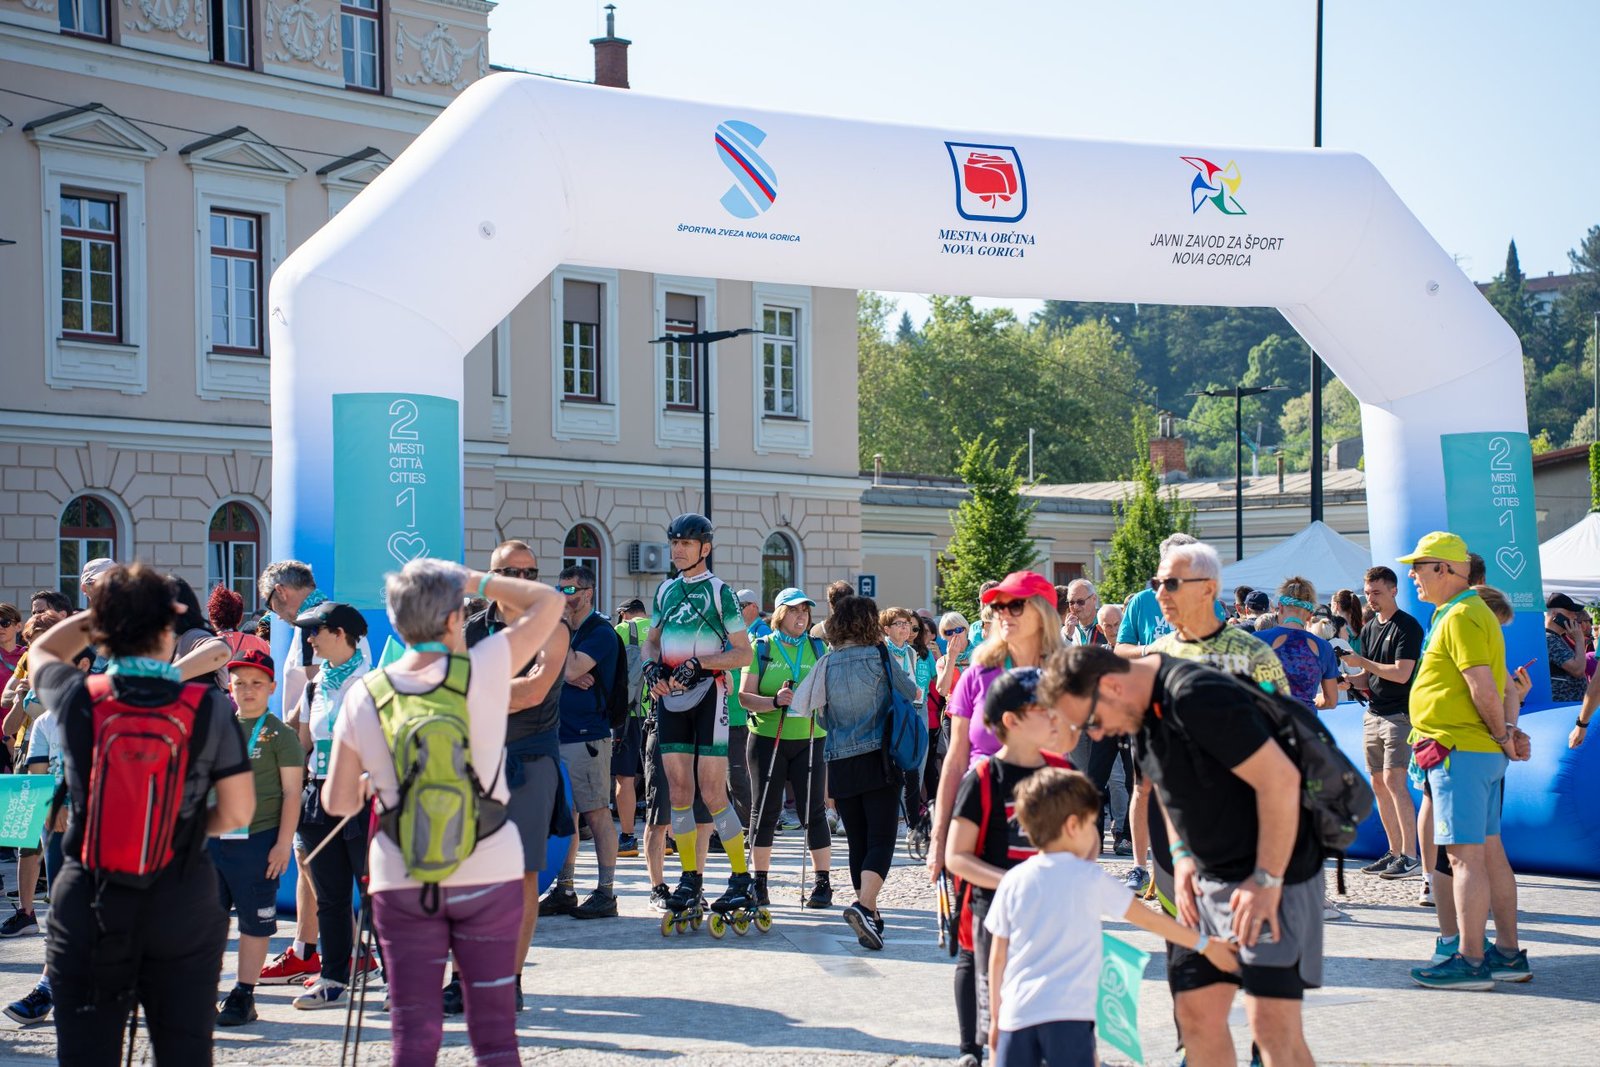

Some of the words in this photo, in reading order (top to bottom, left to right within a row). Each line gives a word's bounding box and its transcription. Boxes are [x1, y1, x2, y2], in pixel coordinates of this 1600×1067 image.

[677, 223, 717, 236] ŠPORTNA
[718, 228, 744, 238] ZVEZA
[745, 231, 768, 240] NOVA
[769, 233, 801, 242] GORICA
[938, 229, 988, 243] MESTNA
[990, 230, 1036, 246] OBČINA
[1150, 233, 1184, 247] JAVNI
[1185, 234, 1225, 249] ZAVOD
[1227, 235, 1242, 249] ZA
[1244, 234, 1285, 250] ŠPORT
[940, 243, 974, 255] NOVA
[977, 245, 1025, 258] GORICA
[1171, 252, 1205, 265] NOVA
[1206, 253, 1252, 266] GORICA
[388, 398, 419, 441] 2
[389, 442, 425, 455] MESTI
[1488, 436, 1513, 471] 2
[389, 456, 423, 470] CITTÀ
[389, 471, 426, 484] CITIES
[1491, 472, 1517, 483] MESTI
[1492, 484, 1517, 495] CITTÀ
[395, 486, 416, 528] 1
[1493, 497, 1520, 507] CITIES
[1499, 509, 1516, 544] 1
